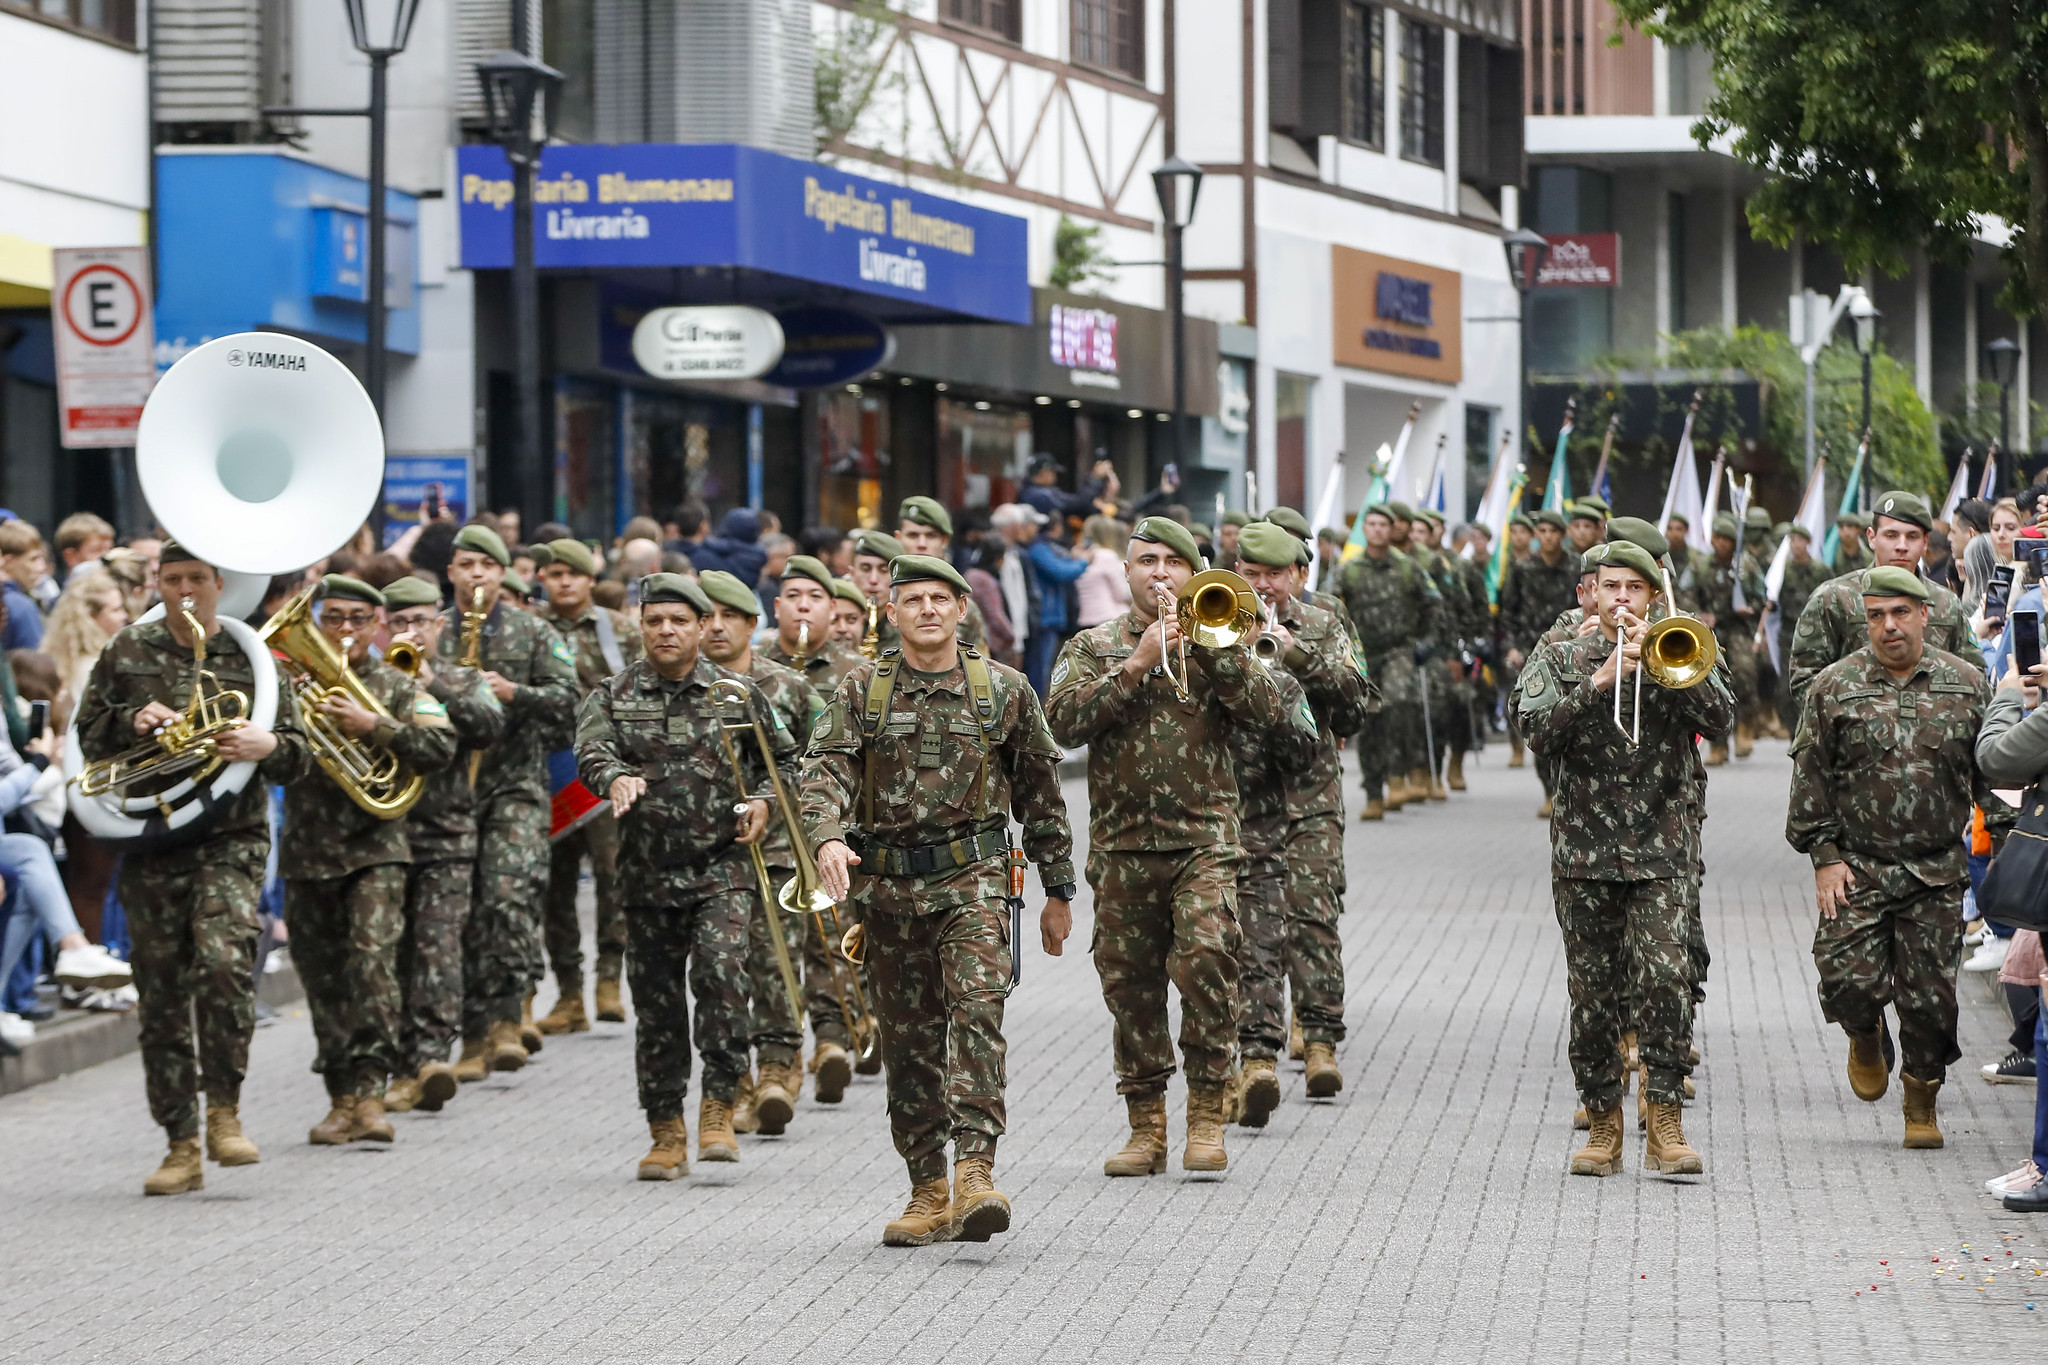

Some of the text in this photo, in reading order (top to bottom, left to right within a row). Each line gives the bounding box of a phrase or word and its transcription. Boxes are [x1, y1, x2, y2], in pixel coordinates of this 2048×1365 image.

[462, 172, 734, 211] Paplaria Blumenau
[546, 207, 650, 240] Livraria
[804, 176, 976, 256] Papelaria Blumenau
[859, 236, 927, 292] Livraria
[88, 282, 118, 329] E
[247, 351, 307, 371] YAMAHA
